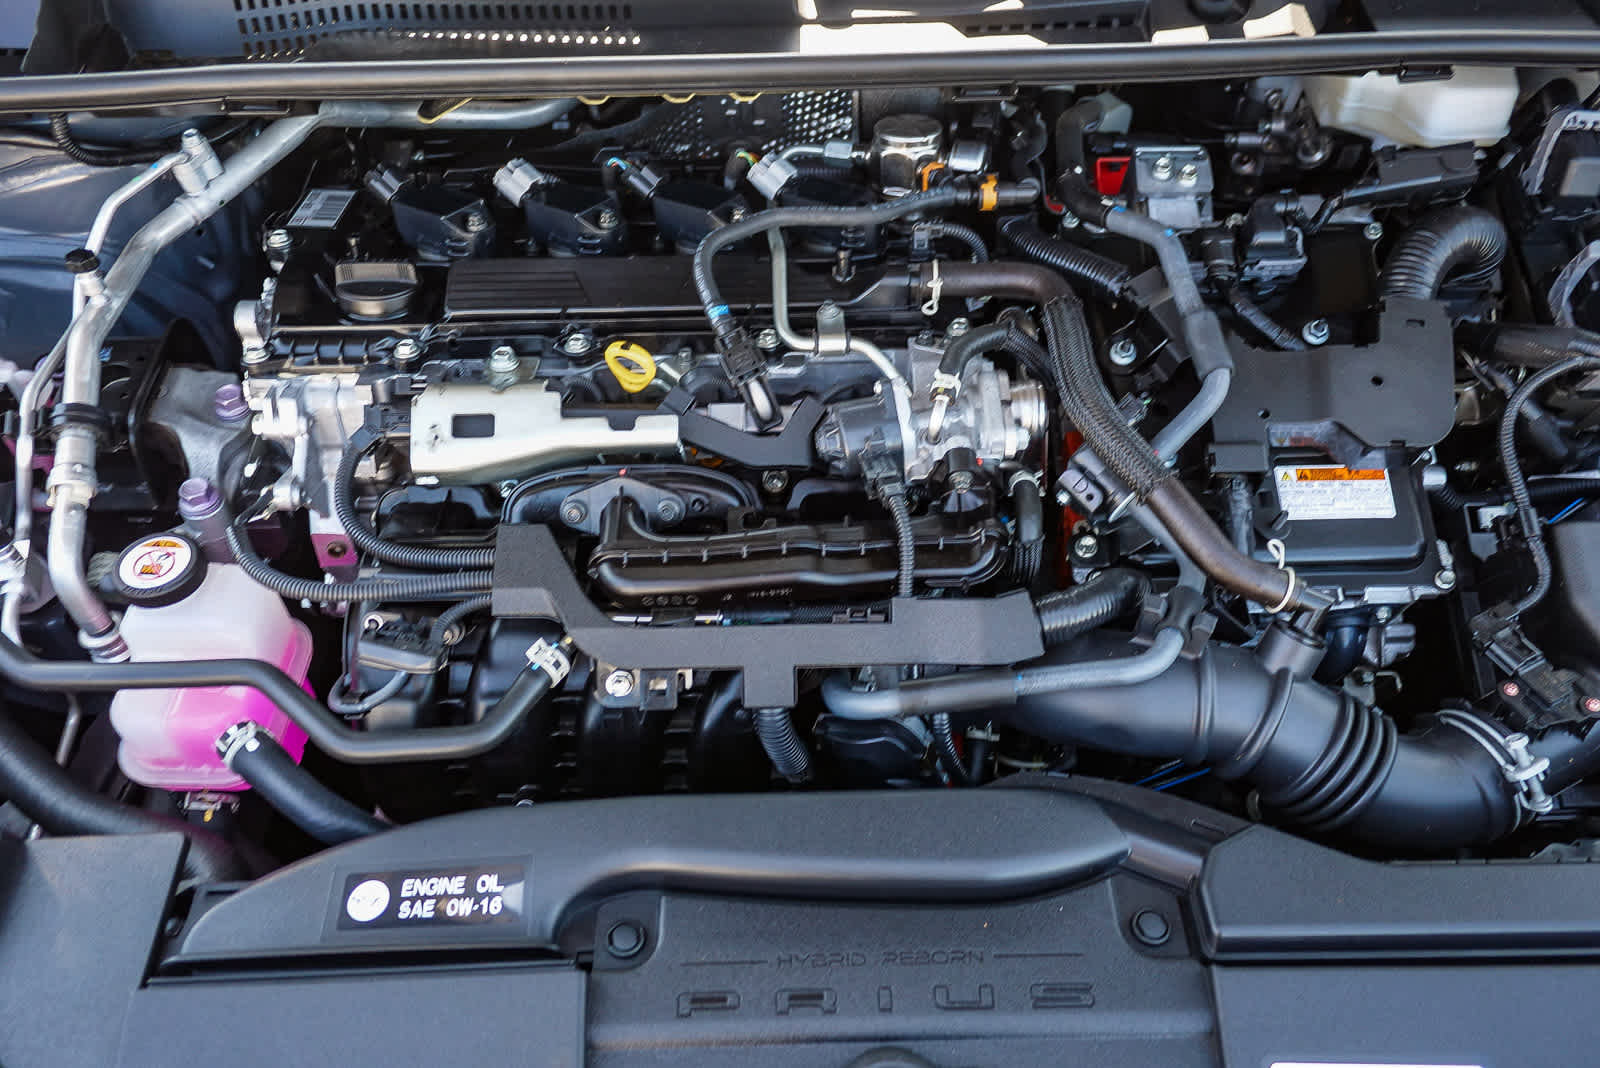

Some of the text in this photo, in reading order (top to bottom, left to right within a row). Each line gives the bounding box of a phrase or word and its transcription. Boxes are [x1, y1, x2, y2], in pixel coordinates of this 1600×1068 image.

[400, 874, 504, 897] ENGINE OIL
[398, 900, 436, 919] SAE
[446, 897, 503, 916] 0W-16
[776, 950, 984, 968] HYBRID REBORN
[677, 982, 1095, 1017] PRIUS
